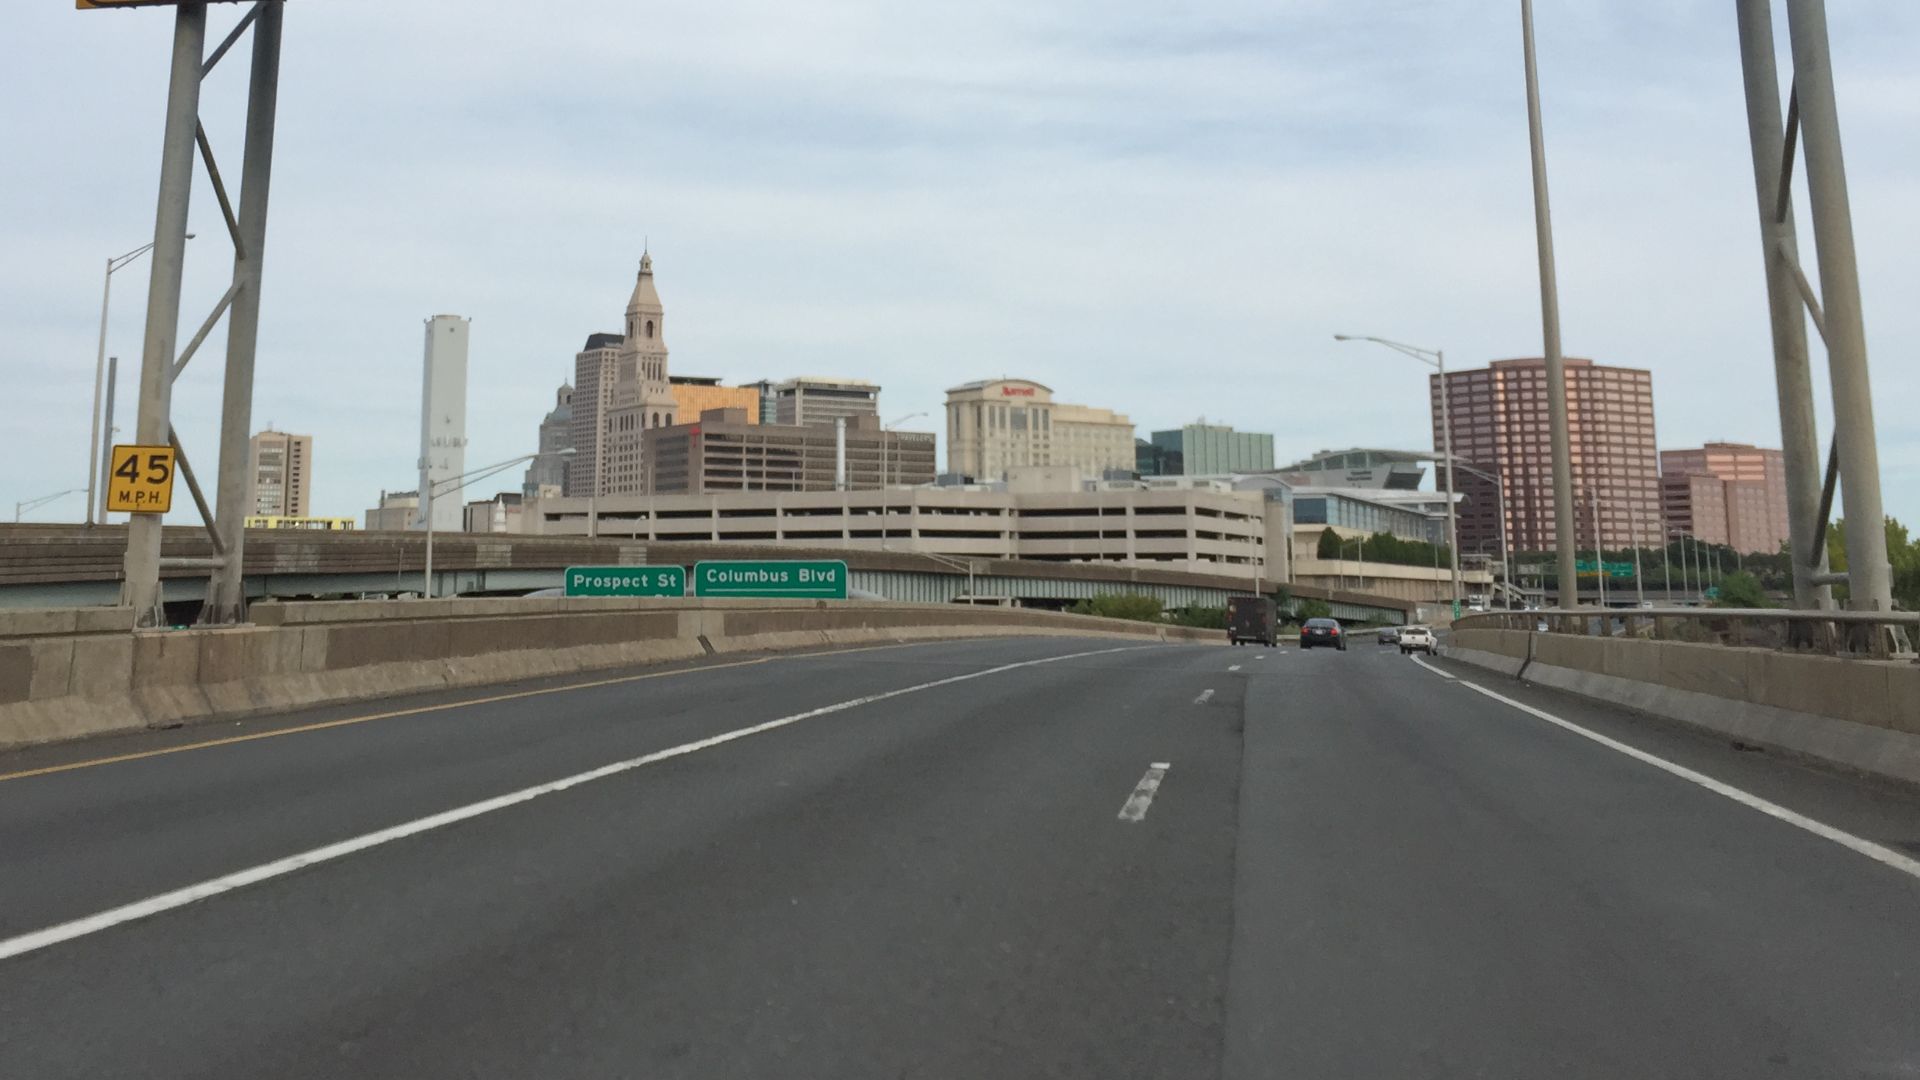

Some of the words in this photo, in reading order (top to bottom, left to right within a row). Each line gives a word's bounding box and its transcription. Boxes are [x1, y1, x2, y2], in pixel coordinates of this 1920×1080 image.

[115, 454, 169, 484] 45
[573, 574, 649, 590] Prospect
[657, 573, 677, 587] St
[706, 568, 789, 582] Columbus
[798, 568, 836, 582] Blvd
